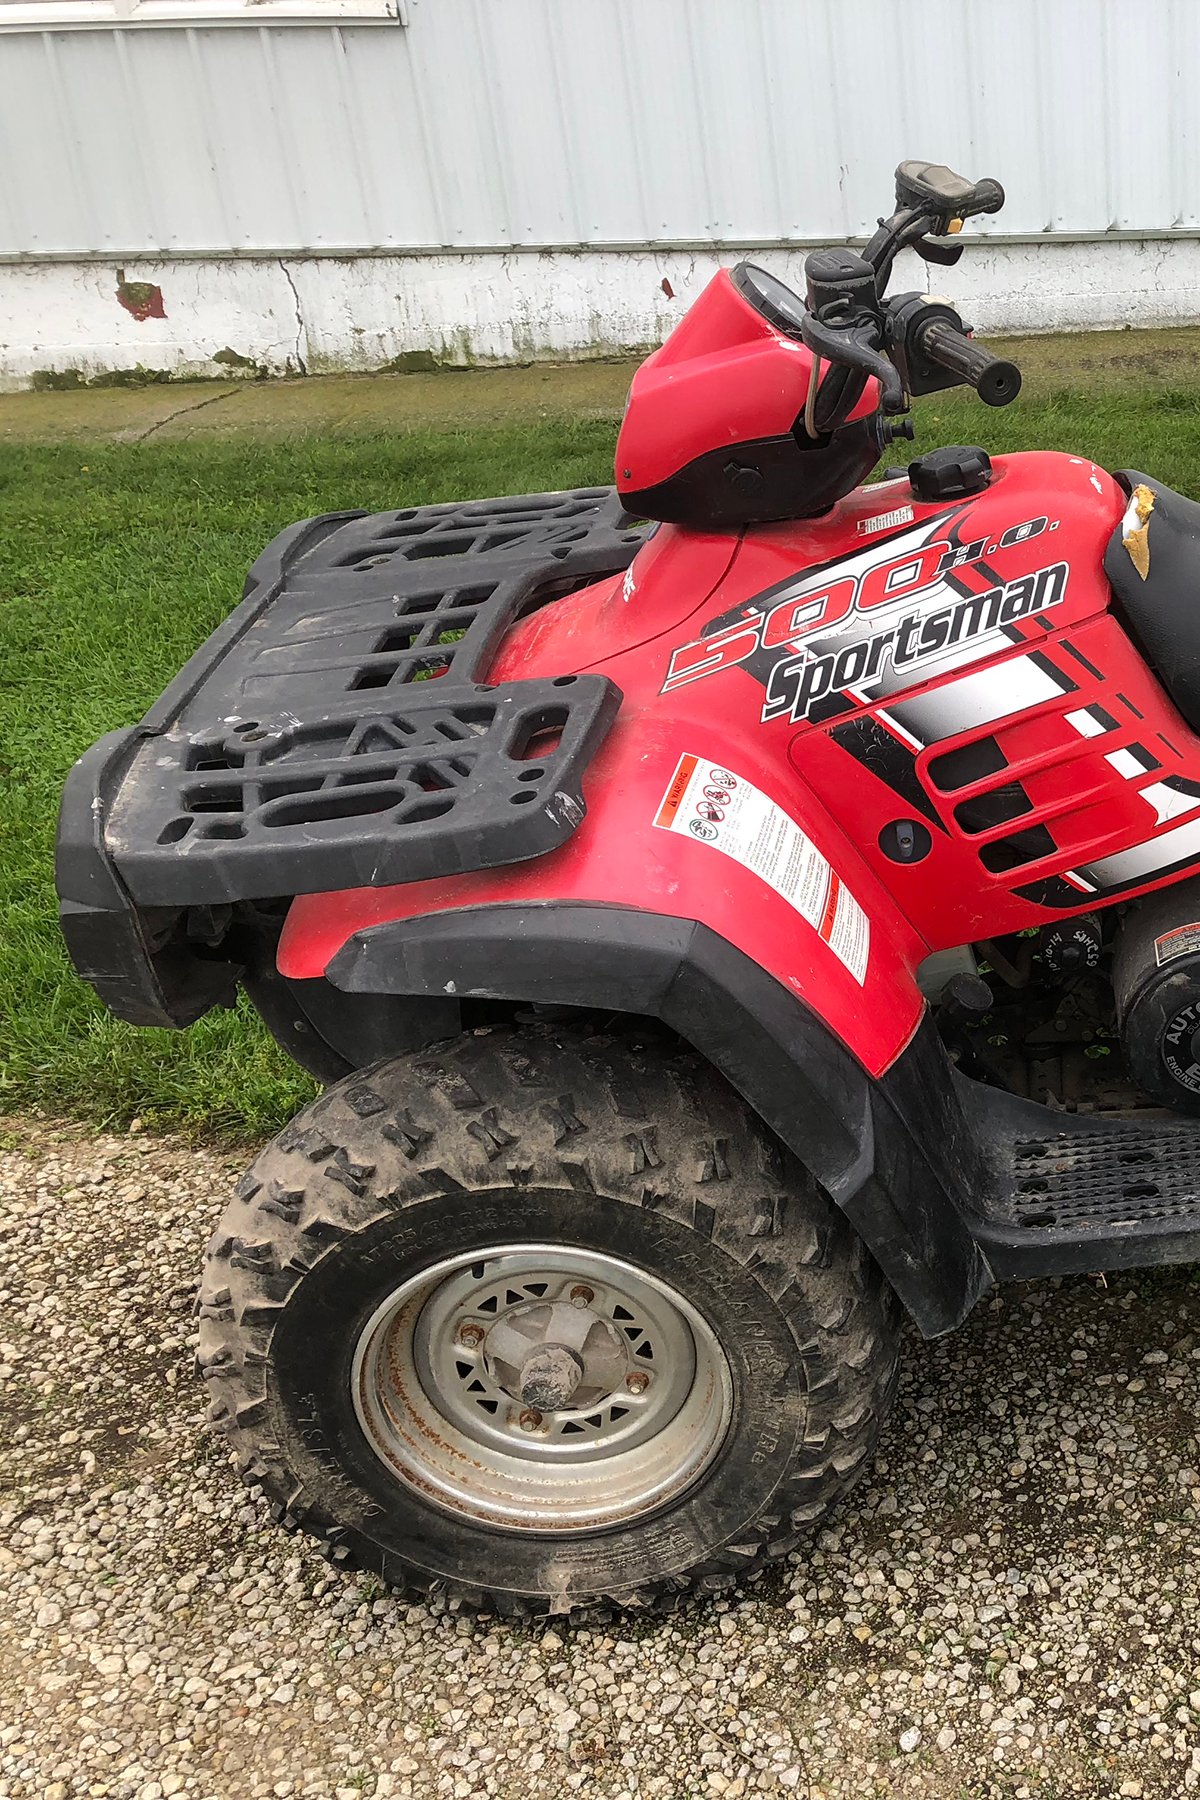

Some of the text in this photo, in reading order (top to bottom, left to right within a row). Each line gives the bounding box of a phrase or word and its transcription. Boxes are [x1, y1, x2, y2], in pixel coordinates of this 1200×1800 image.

[658, 514, 1061, 696] 500 H.O.
[760, 560, 1070, 724] Sportsman
[1166, 1055, 1197, 1088] ENGINE
